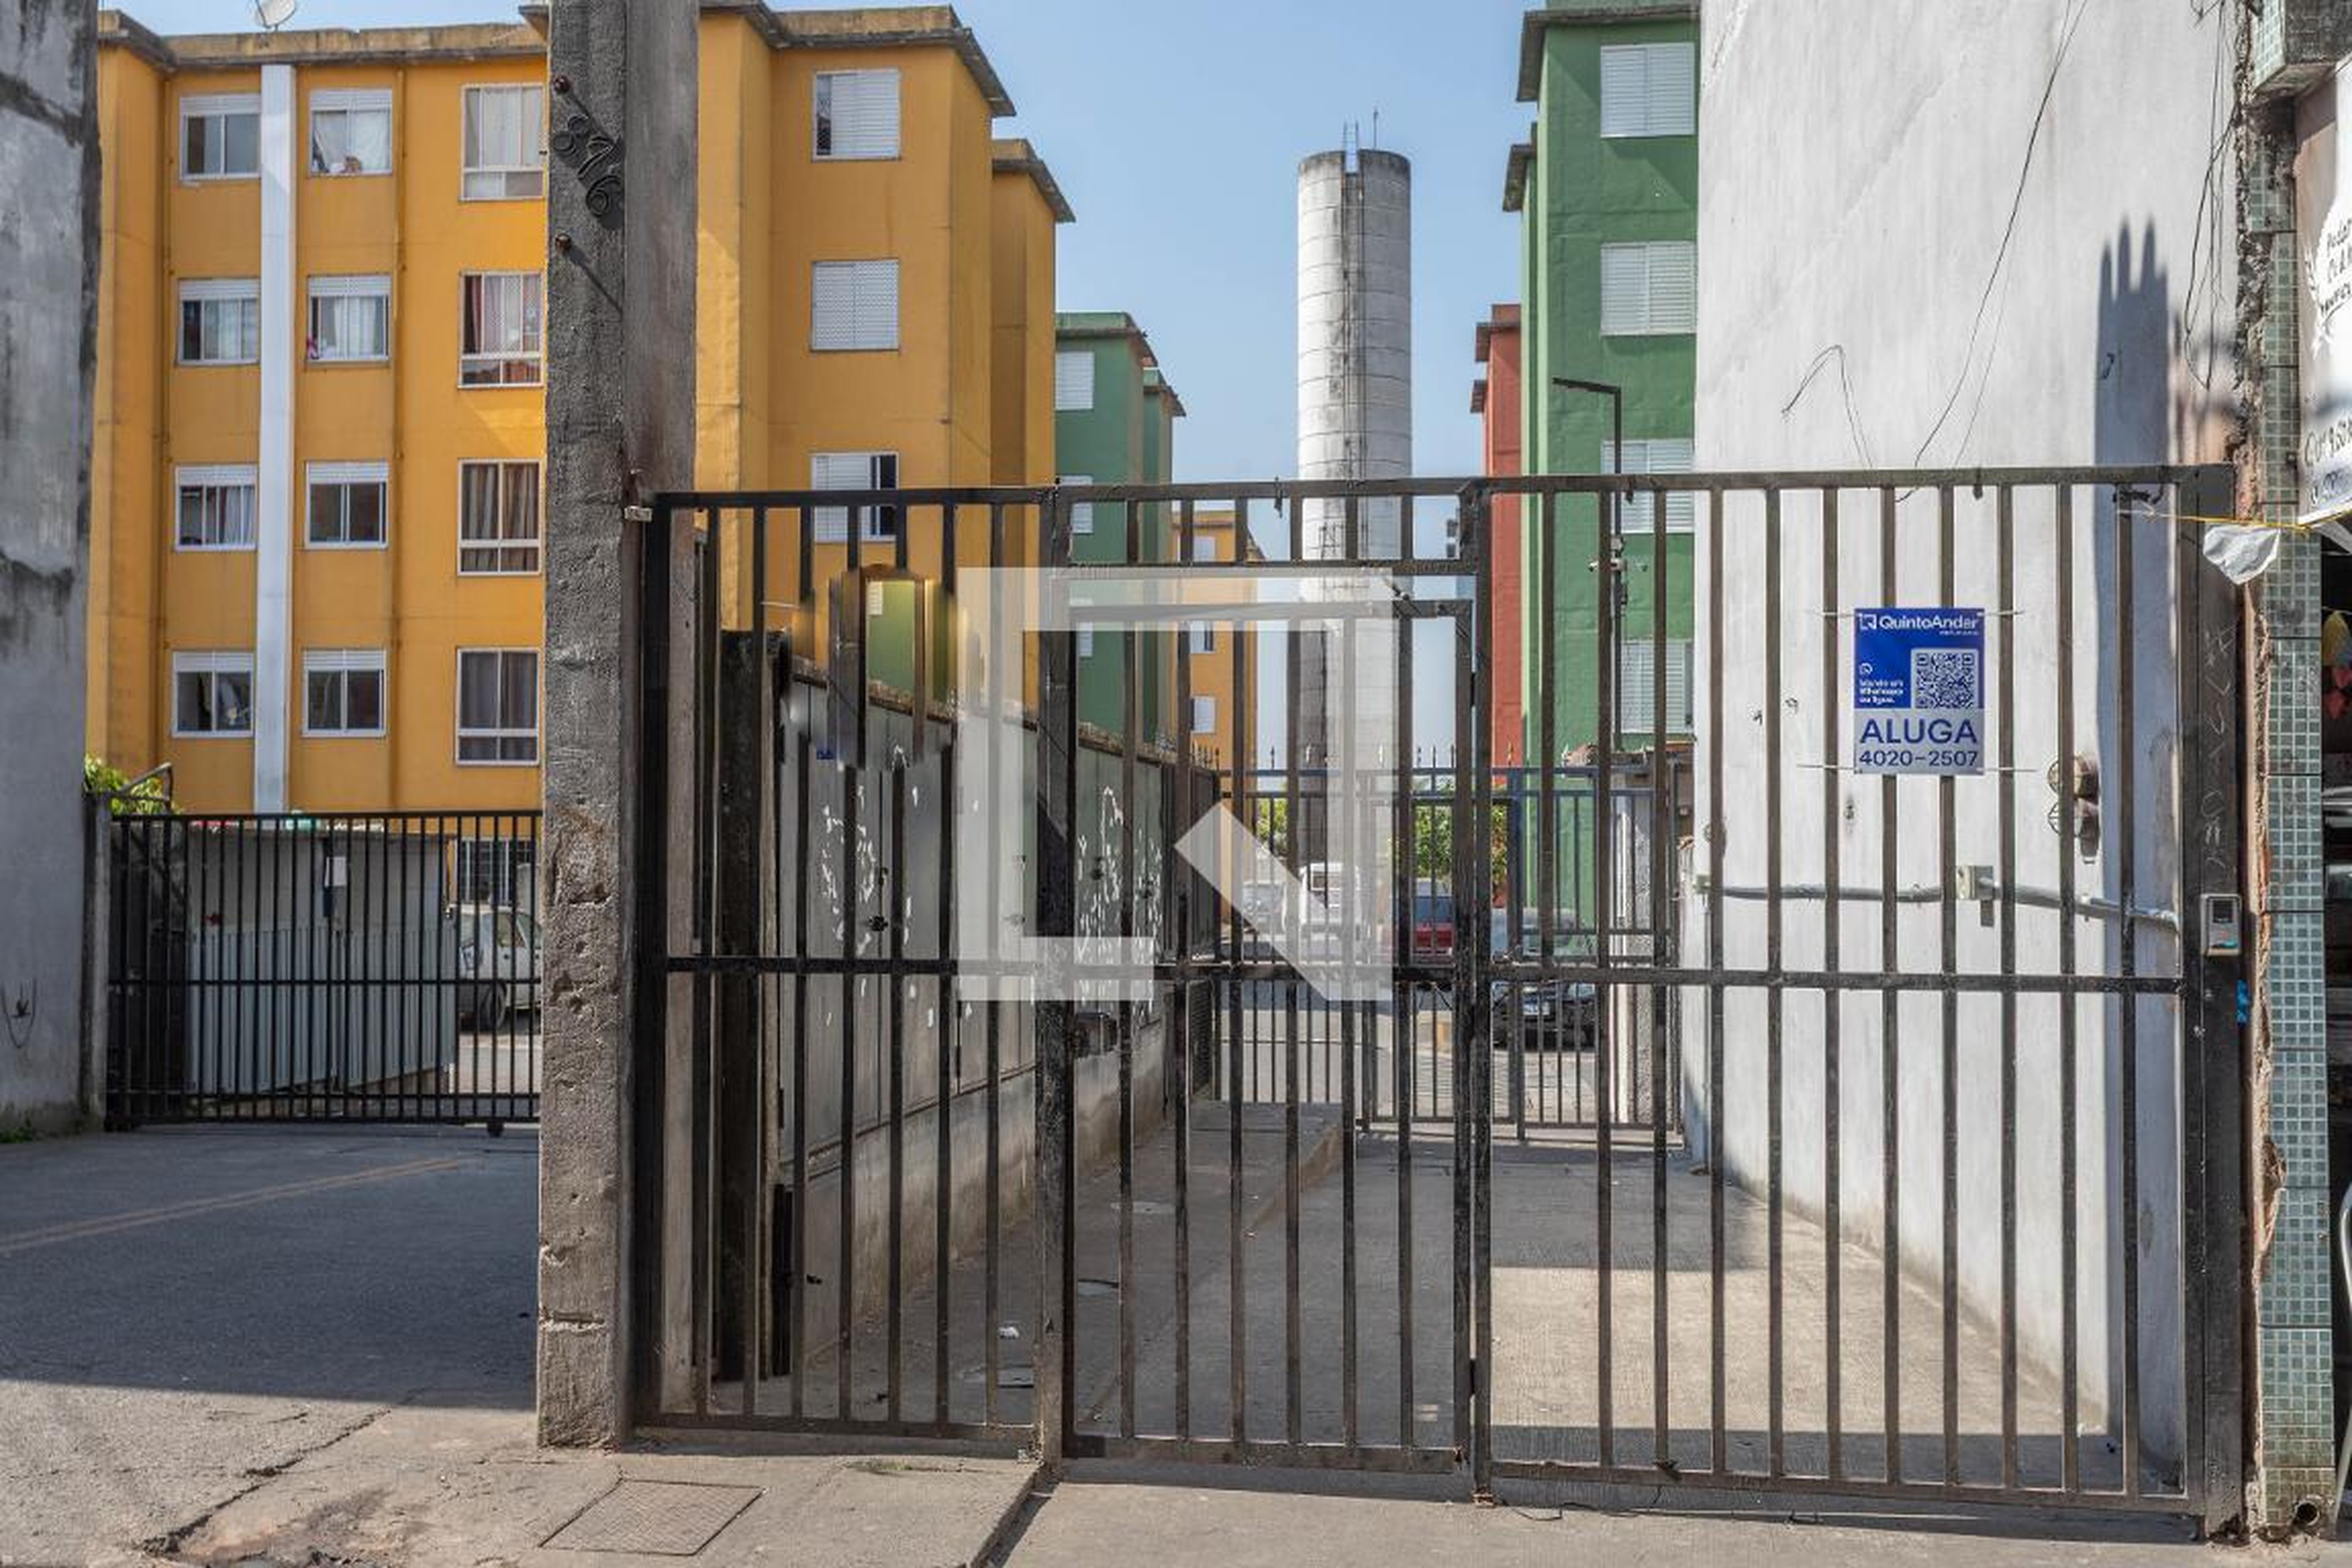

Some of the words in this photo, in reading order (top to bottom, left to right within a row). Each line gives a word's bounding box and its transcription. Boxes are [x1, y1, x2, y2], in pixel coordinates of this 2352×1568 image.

[1879, 614, 1978, 629] QuintoAndar
[1860, 719, 1978, 744] ALUGA
[1859, 750, 1978, 766] 4020-2507
